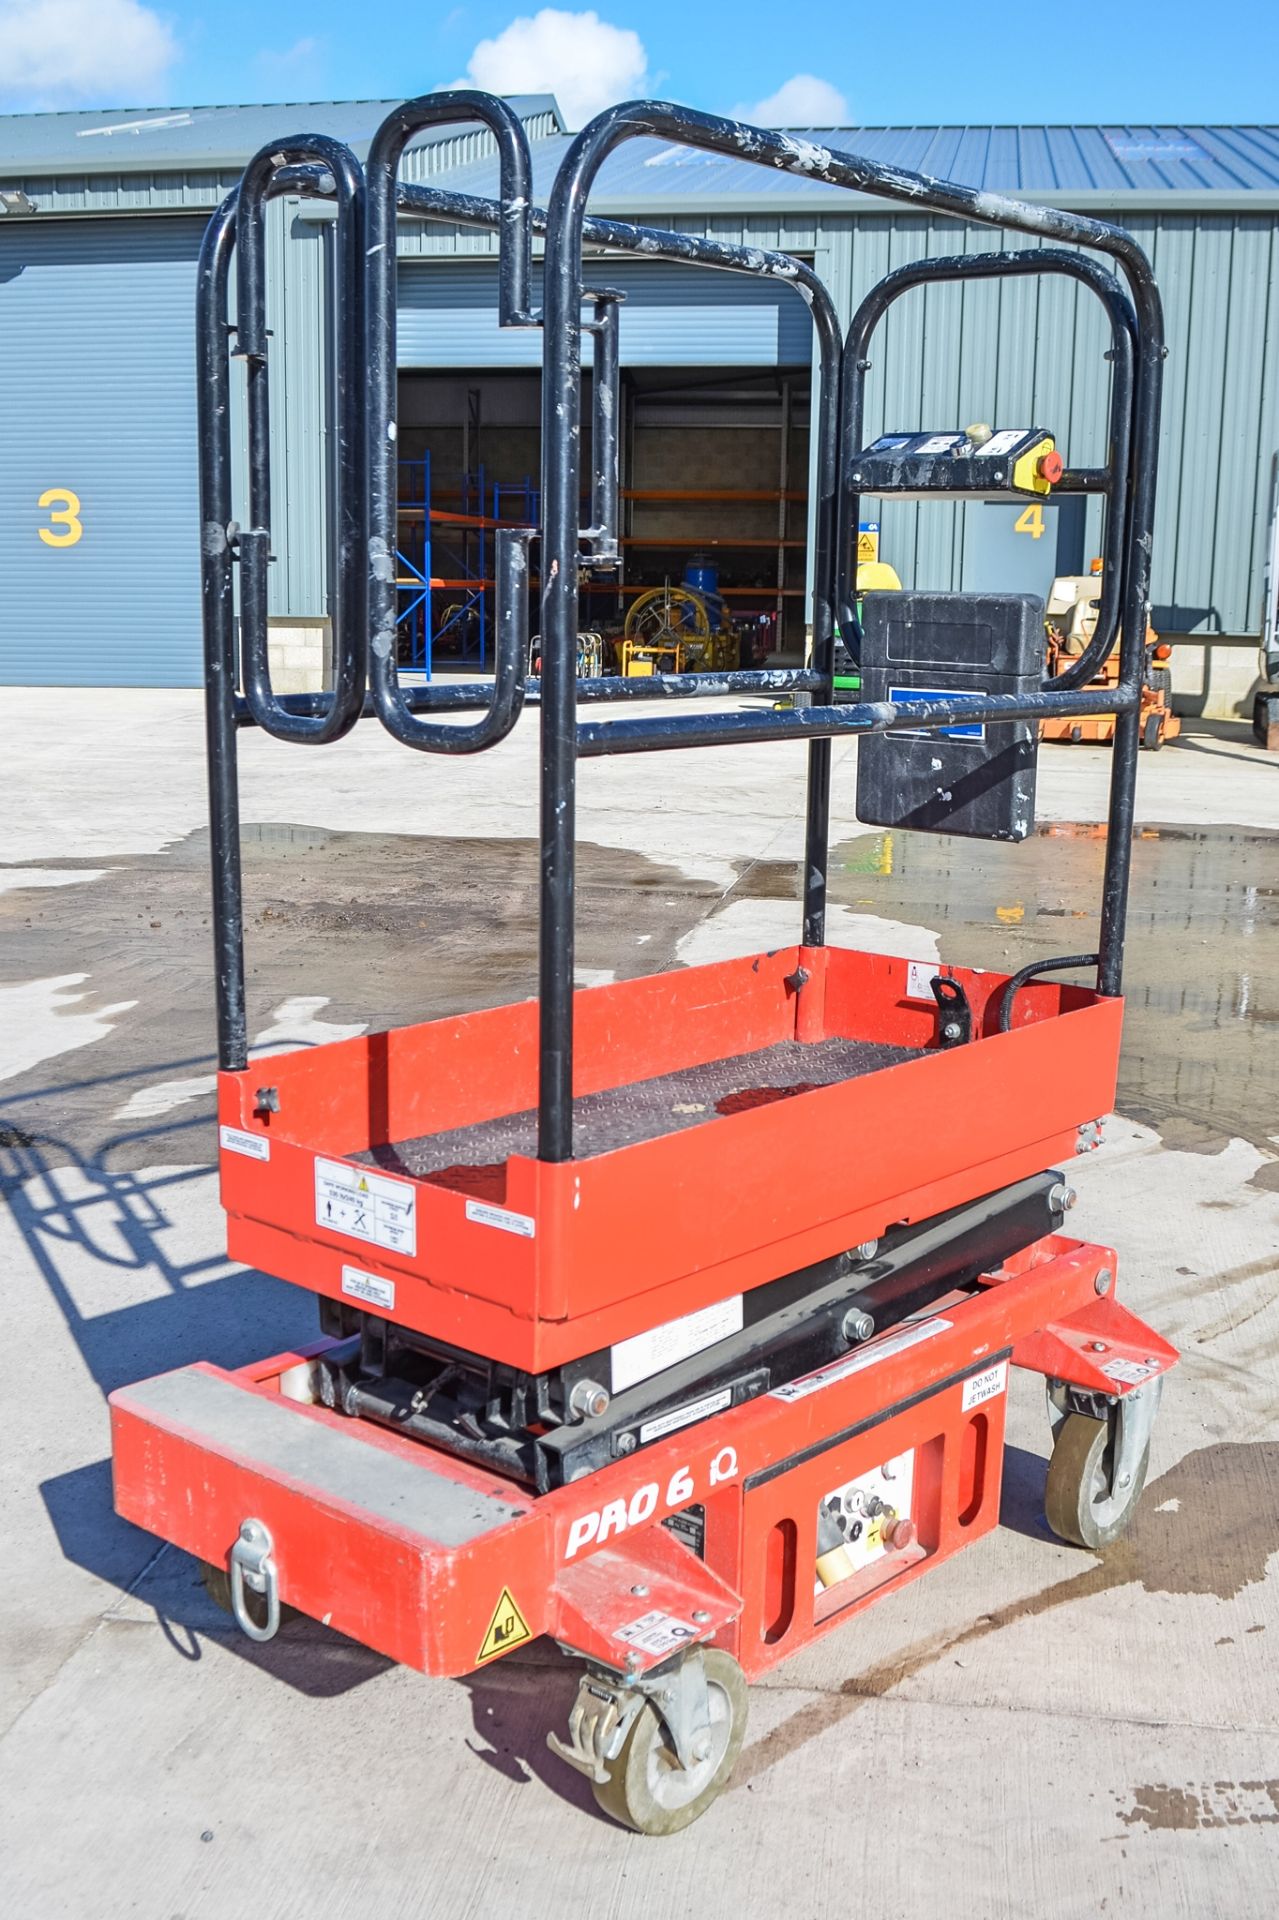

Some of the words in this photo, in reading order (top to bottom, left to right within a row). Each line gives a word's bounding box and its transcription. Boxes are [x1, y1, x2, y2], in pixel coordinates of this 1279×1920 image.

[37, 488, 83, 548] 3
[1014, 503, 1045, 539] 4
[968, 1382, 1000, 1405] JETWASH
[972, 1377, 983, 1390] DO
[984, 1370, 998, 1382] NOT
[564, 1482, 660, 1560] PRO
[666, 1465, 695, 1507] 6
